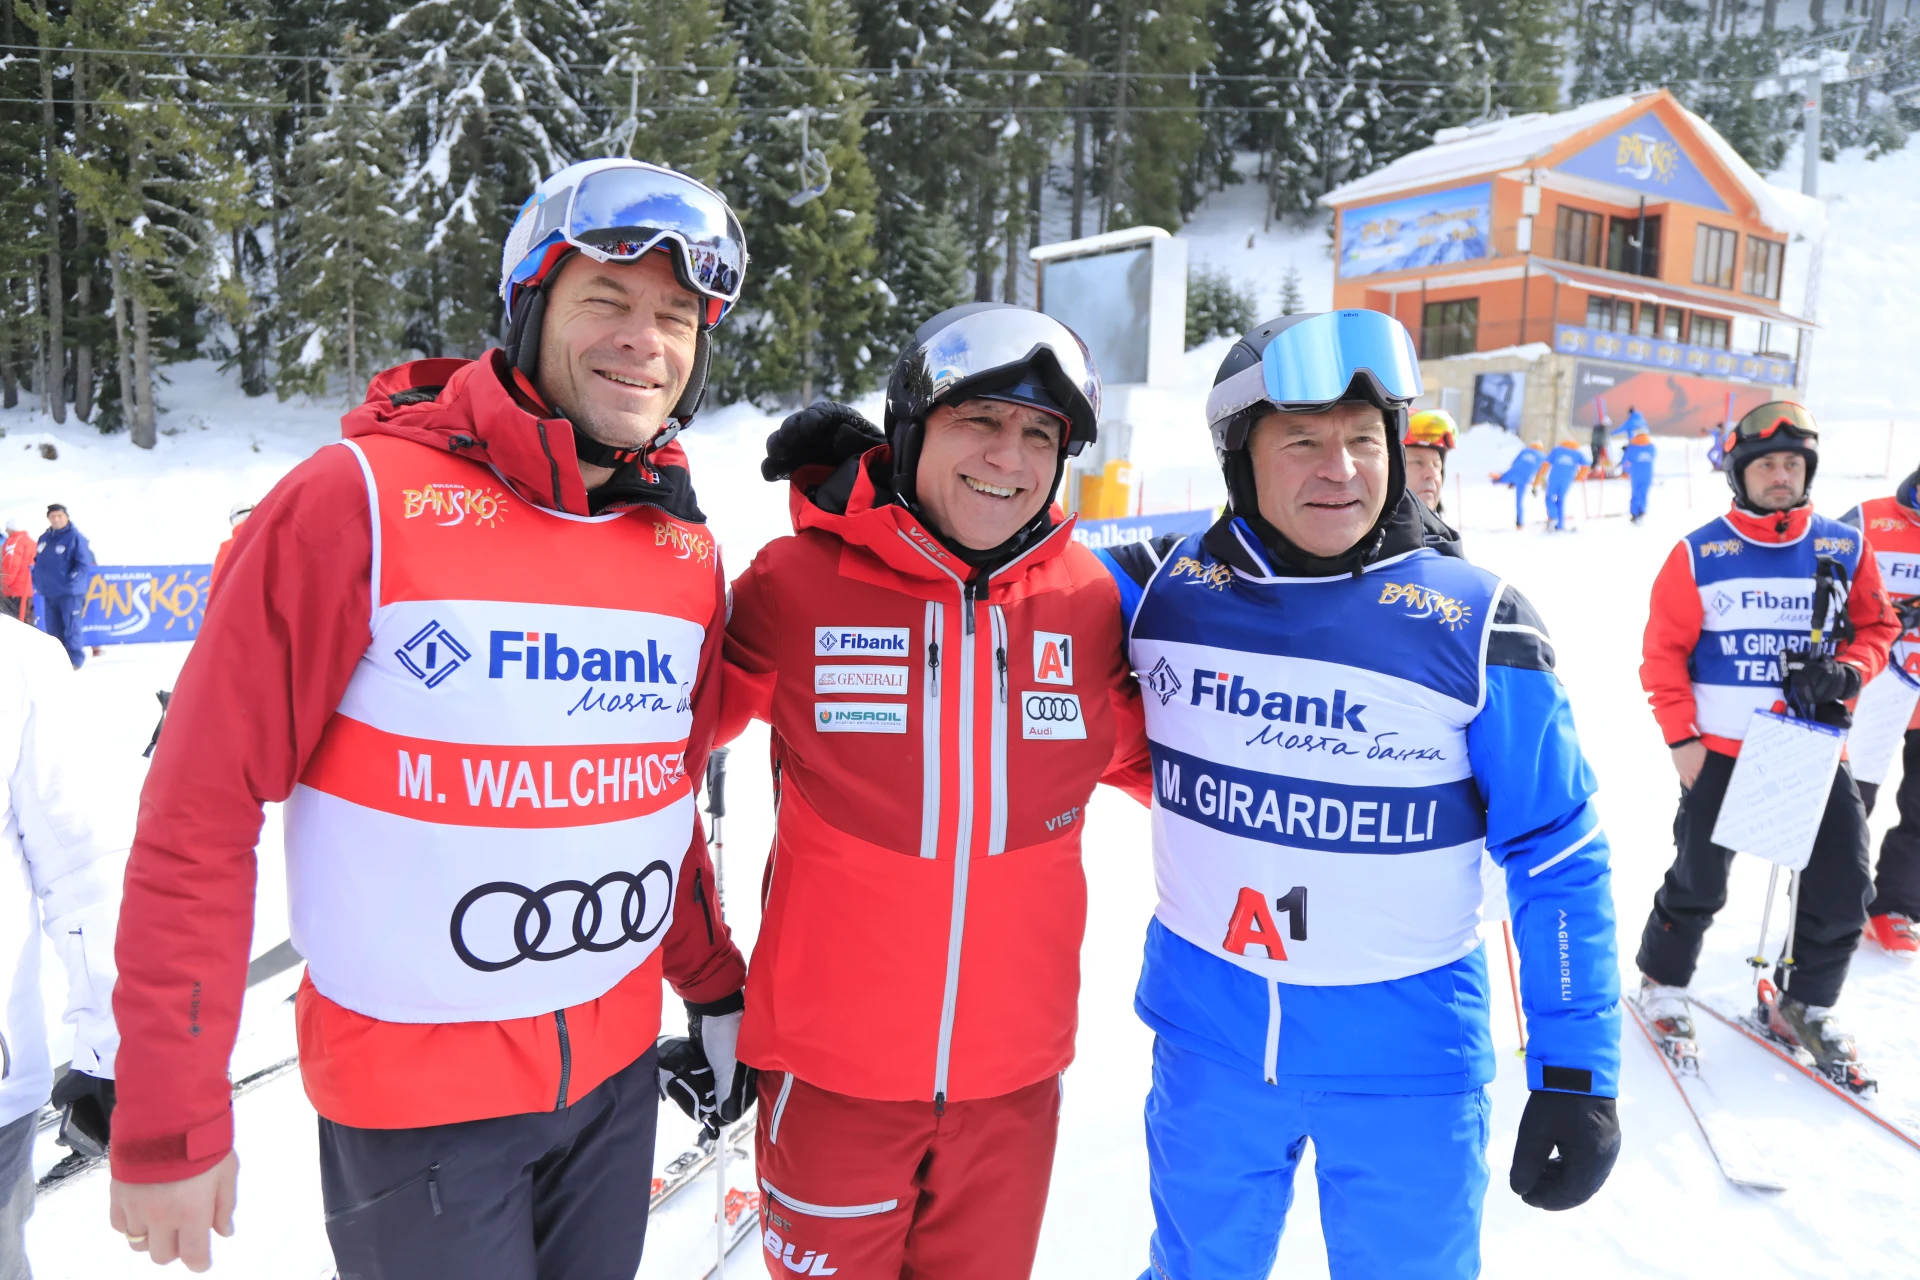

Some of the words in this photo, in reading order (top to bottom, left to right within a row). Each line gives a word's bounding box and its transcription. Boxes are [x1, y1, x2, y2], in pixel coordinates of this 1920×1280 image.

[402, 484, 498, 527] BANSKO
[653, 521, 709, 560] BANSKO
[1073, 523, 1153, 549] Balkan
[82, 573, 199, 636] ANSKO
[1379, 582, 1463, 623] BANSKO
[489, 630, 677, 684] Fibank
[840, 633, 905, 650] Fibank
[1037, 637, 1070, 679] A1
[1720, 635, 1738, 655] M.
[837, 672, 903, 687] GENERALI
[1734, 660, 1783, 682] TEA
[835, 711, 901, 721] INSAOIL
[1190, 668, 1367, 733] Fibank
[1029, 726, 1053, 735] Audi
[399, 750, 446, 803] M.
[1161, 759, 1187, 806] M.
[1195, 774, 1438, 843] GIRARDELLI
[1222, 886, 1308, 961] A1
[1558, 931, 1571, 1001] GIRARDELLI
